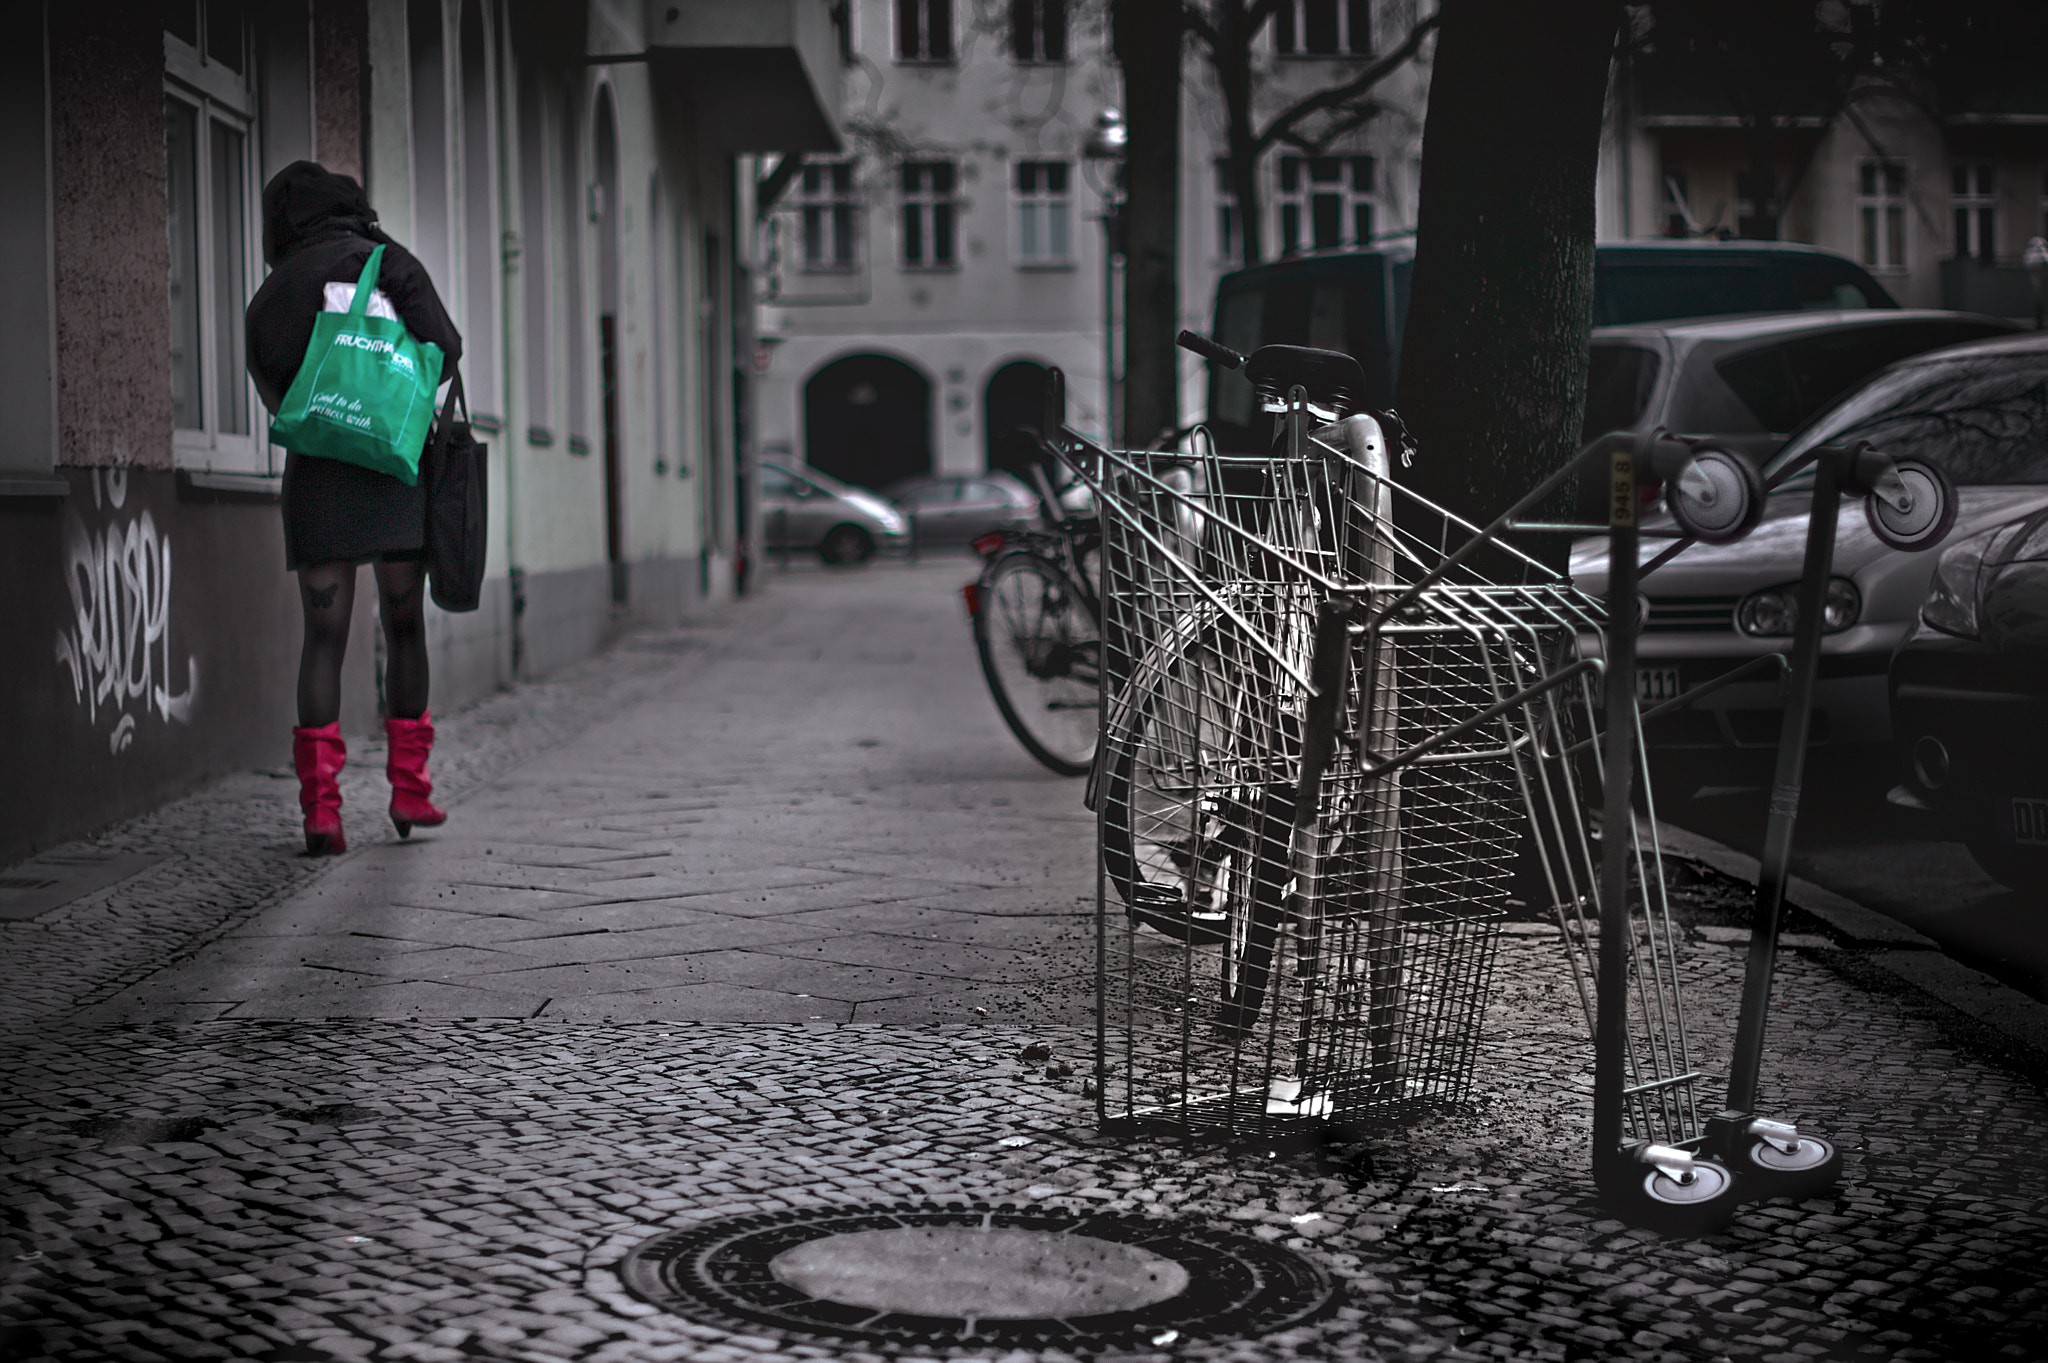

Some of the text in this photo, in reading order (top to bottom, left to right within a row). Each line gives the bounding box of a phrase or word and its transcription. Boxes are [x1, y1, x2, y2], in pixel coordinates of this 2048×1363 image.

[336, 396, 348, 407] to
[348, 398, 362, 412] do
[1613, 481, 1631, 520] 945
[1641, 671, 1677, 700] 111
